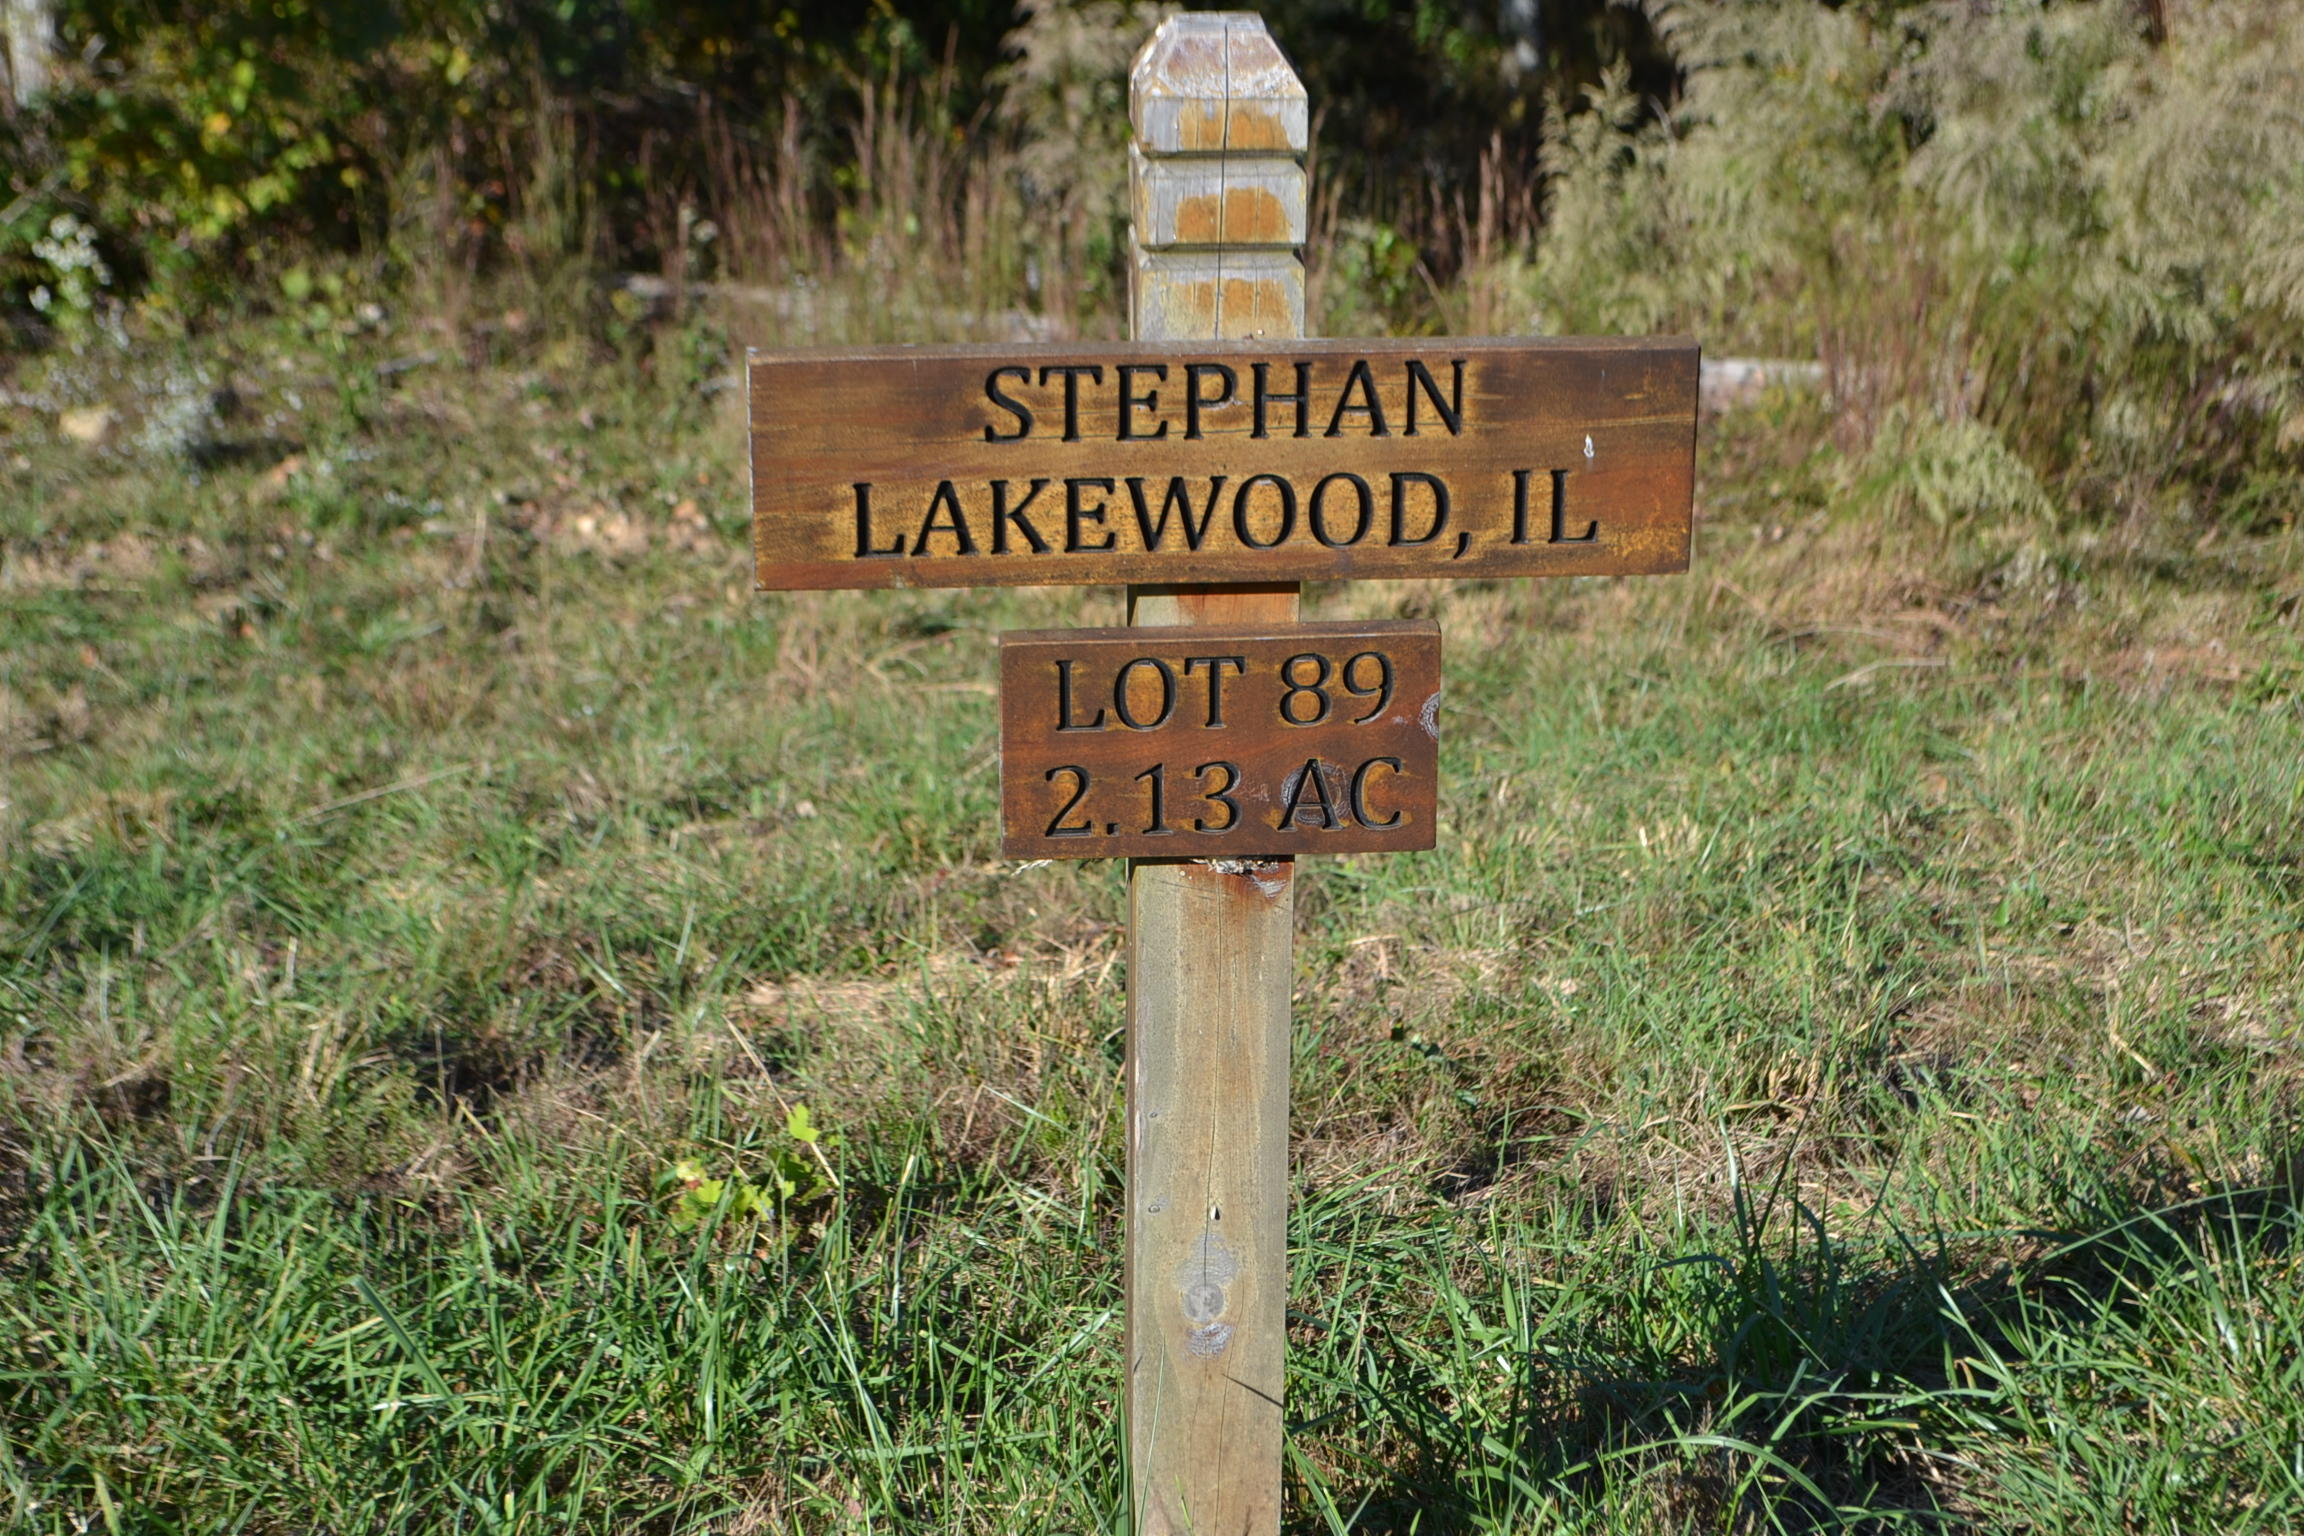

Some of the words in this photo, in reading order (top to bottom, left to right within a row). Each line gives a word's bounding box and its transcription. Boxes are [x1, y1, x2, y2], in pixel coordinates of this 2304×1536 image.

[984, 359, 1467, 444] STEPHAN
[853, 472, 1470, 559] LAKEWOOD,
[1510, 469, 1598, 544] IL
[1056, 655, 1246, 732] LOT
[1279, 652, 1395, 727] 89
[1045, 761, 1241, 837] 2.13
[1277, 757, 1403, 831] AC
